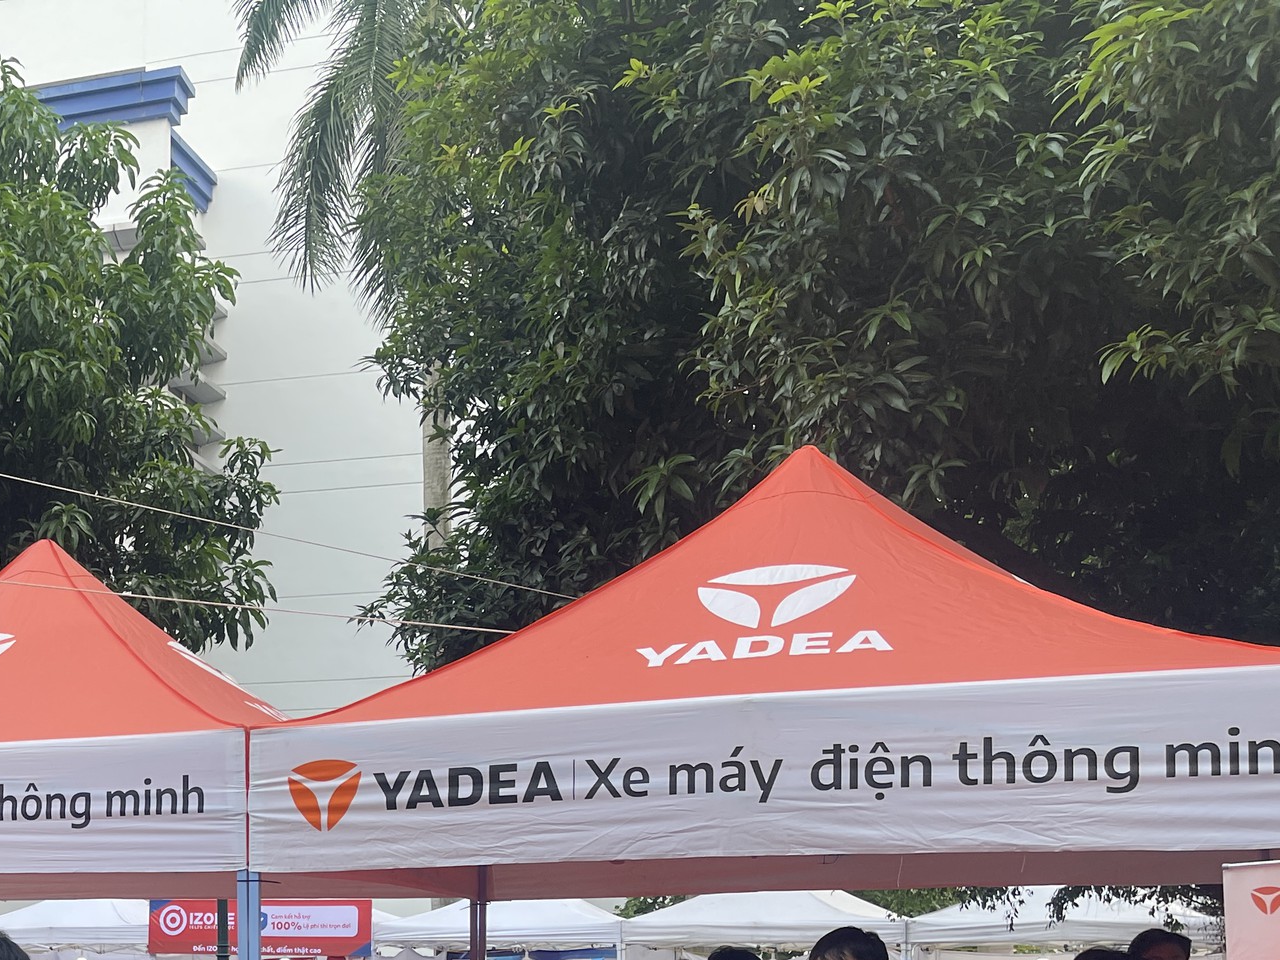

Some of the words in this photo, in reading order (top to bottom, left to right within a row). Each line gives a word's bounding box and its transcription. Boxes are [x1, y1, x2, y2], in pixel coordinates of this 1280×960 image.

[635, 630, 894, 669] YADEA
[373, 761, 562, 811] YADEA
[584, 756, 650, 799] Xe
[668, 745, 783, 804] máy
[810, 742, 933, 800] điện
[952, 735, 1140, 793] thông
[105, 775, 205, 817] minh
[189, 912, 235, 925] IZOE
[271, 921, 302, 930] 100%
